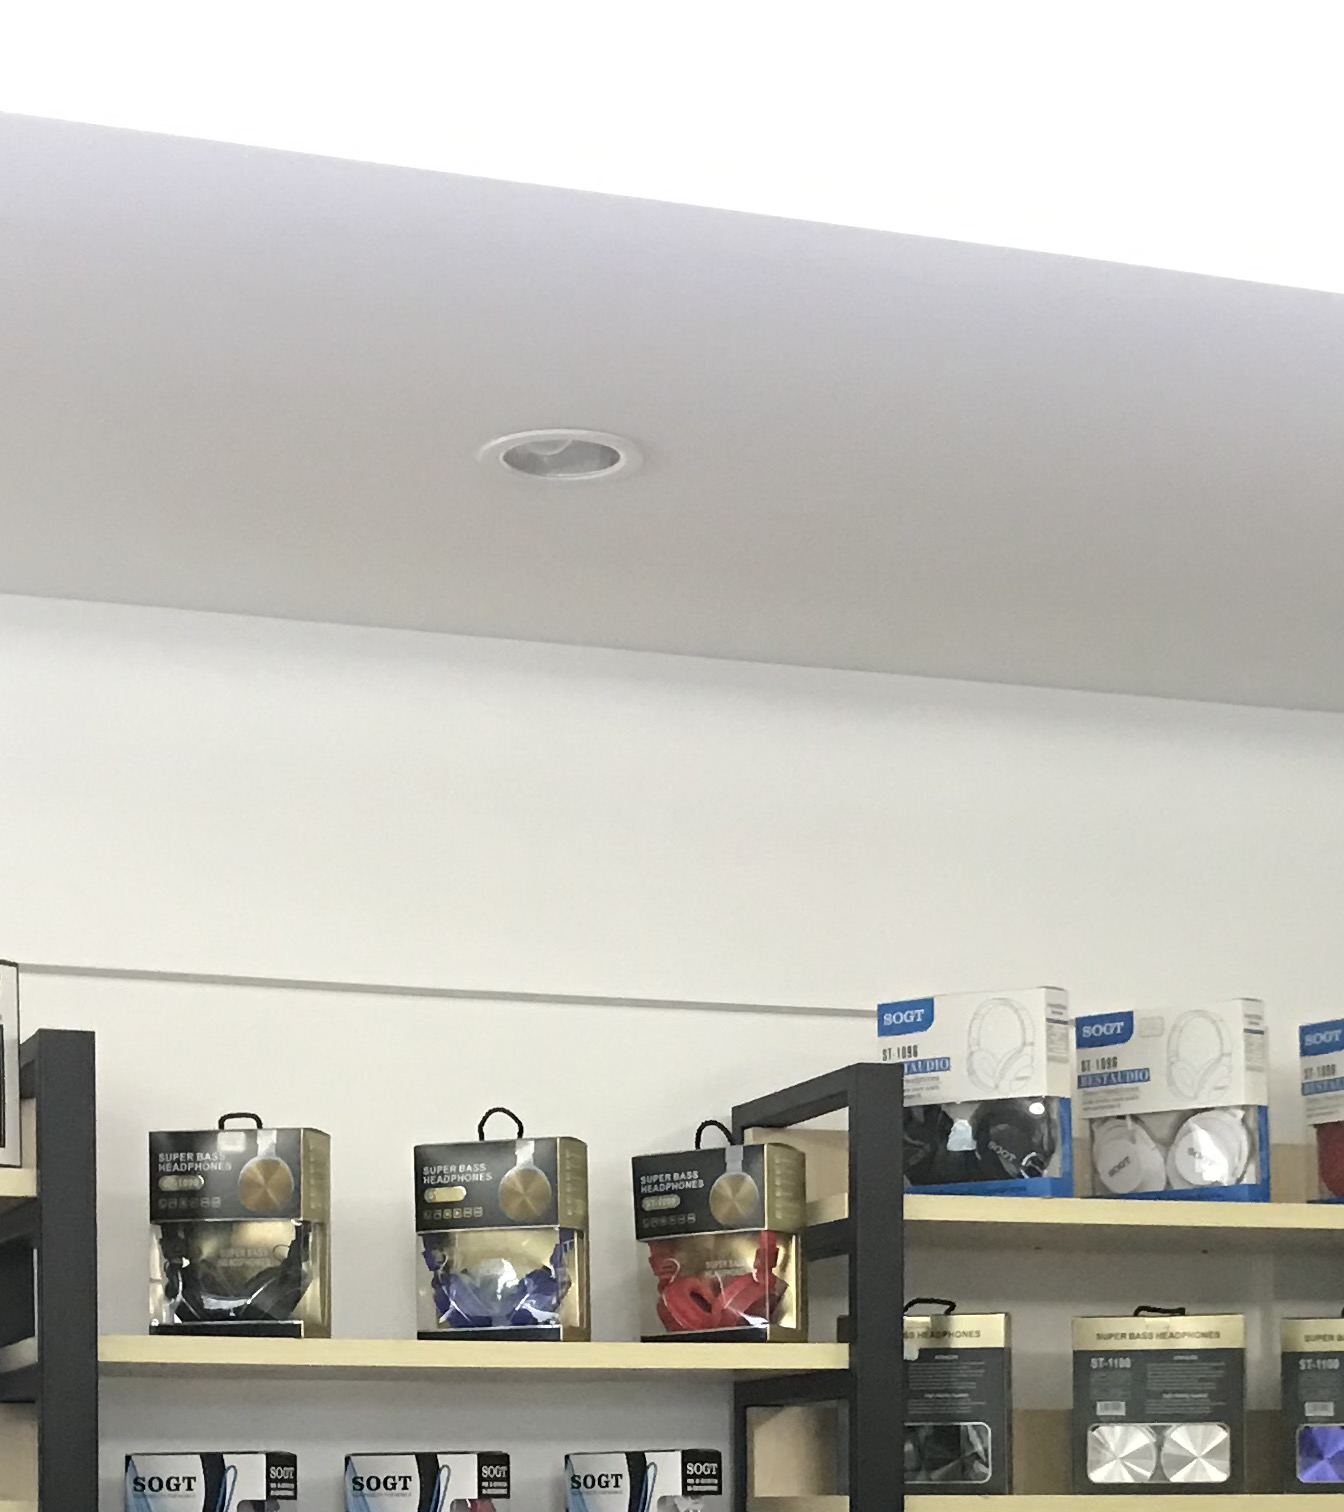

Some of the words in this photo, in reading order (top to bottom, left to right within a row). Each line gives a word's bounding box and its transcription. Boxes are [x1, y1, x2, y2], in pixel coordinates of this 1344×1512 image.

[883, 1009, 925, 1026] SOGT
[1082, 1022, 1125, 1038] SOGT
[1305, 1030, 1343, 1046] SOGT
[158, 1152, 195, 1163] SUPER
[196, 1152, 227, 1163] BASS
[158, 1162, 233, 1172] HEADPHONES
[422, 1164, 457, 1176] SUPER
[458, 1162, 487, 1173] BASS
[422, 1172, 493, 1184] HEADPHONES
[640, 1173, 672, 1185] SUPER
[673, 1170, 699, 1181] BASS
[640, 1179, 705, 1194] HEADPHONES
[917, 1330, 981, 1340] HEADPHONES
[1096, 1332, 1127, 1341] SUPER
[1128, 1332, 1154, 1340] BASS
[1156, 1330, 1221, 1340] HEADPHONES
[1304, 1334, 1335, 1342] SUPER
[269, 1466, 295, 1480] SOGT
[481, 1465, 508, 1479] SOGT
[686, 1462, 719, 1476] SOGT
[133, 1476, 197, 1493] SOGT
[351, 1475, 413, 1492] SOGT
[570, 1473, 624, 1490] SOGT
